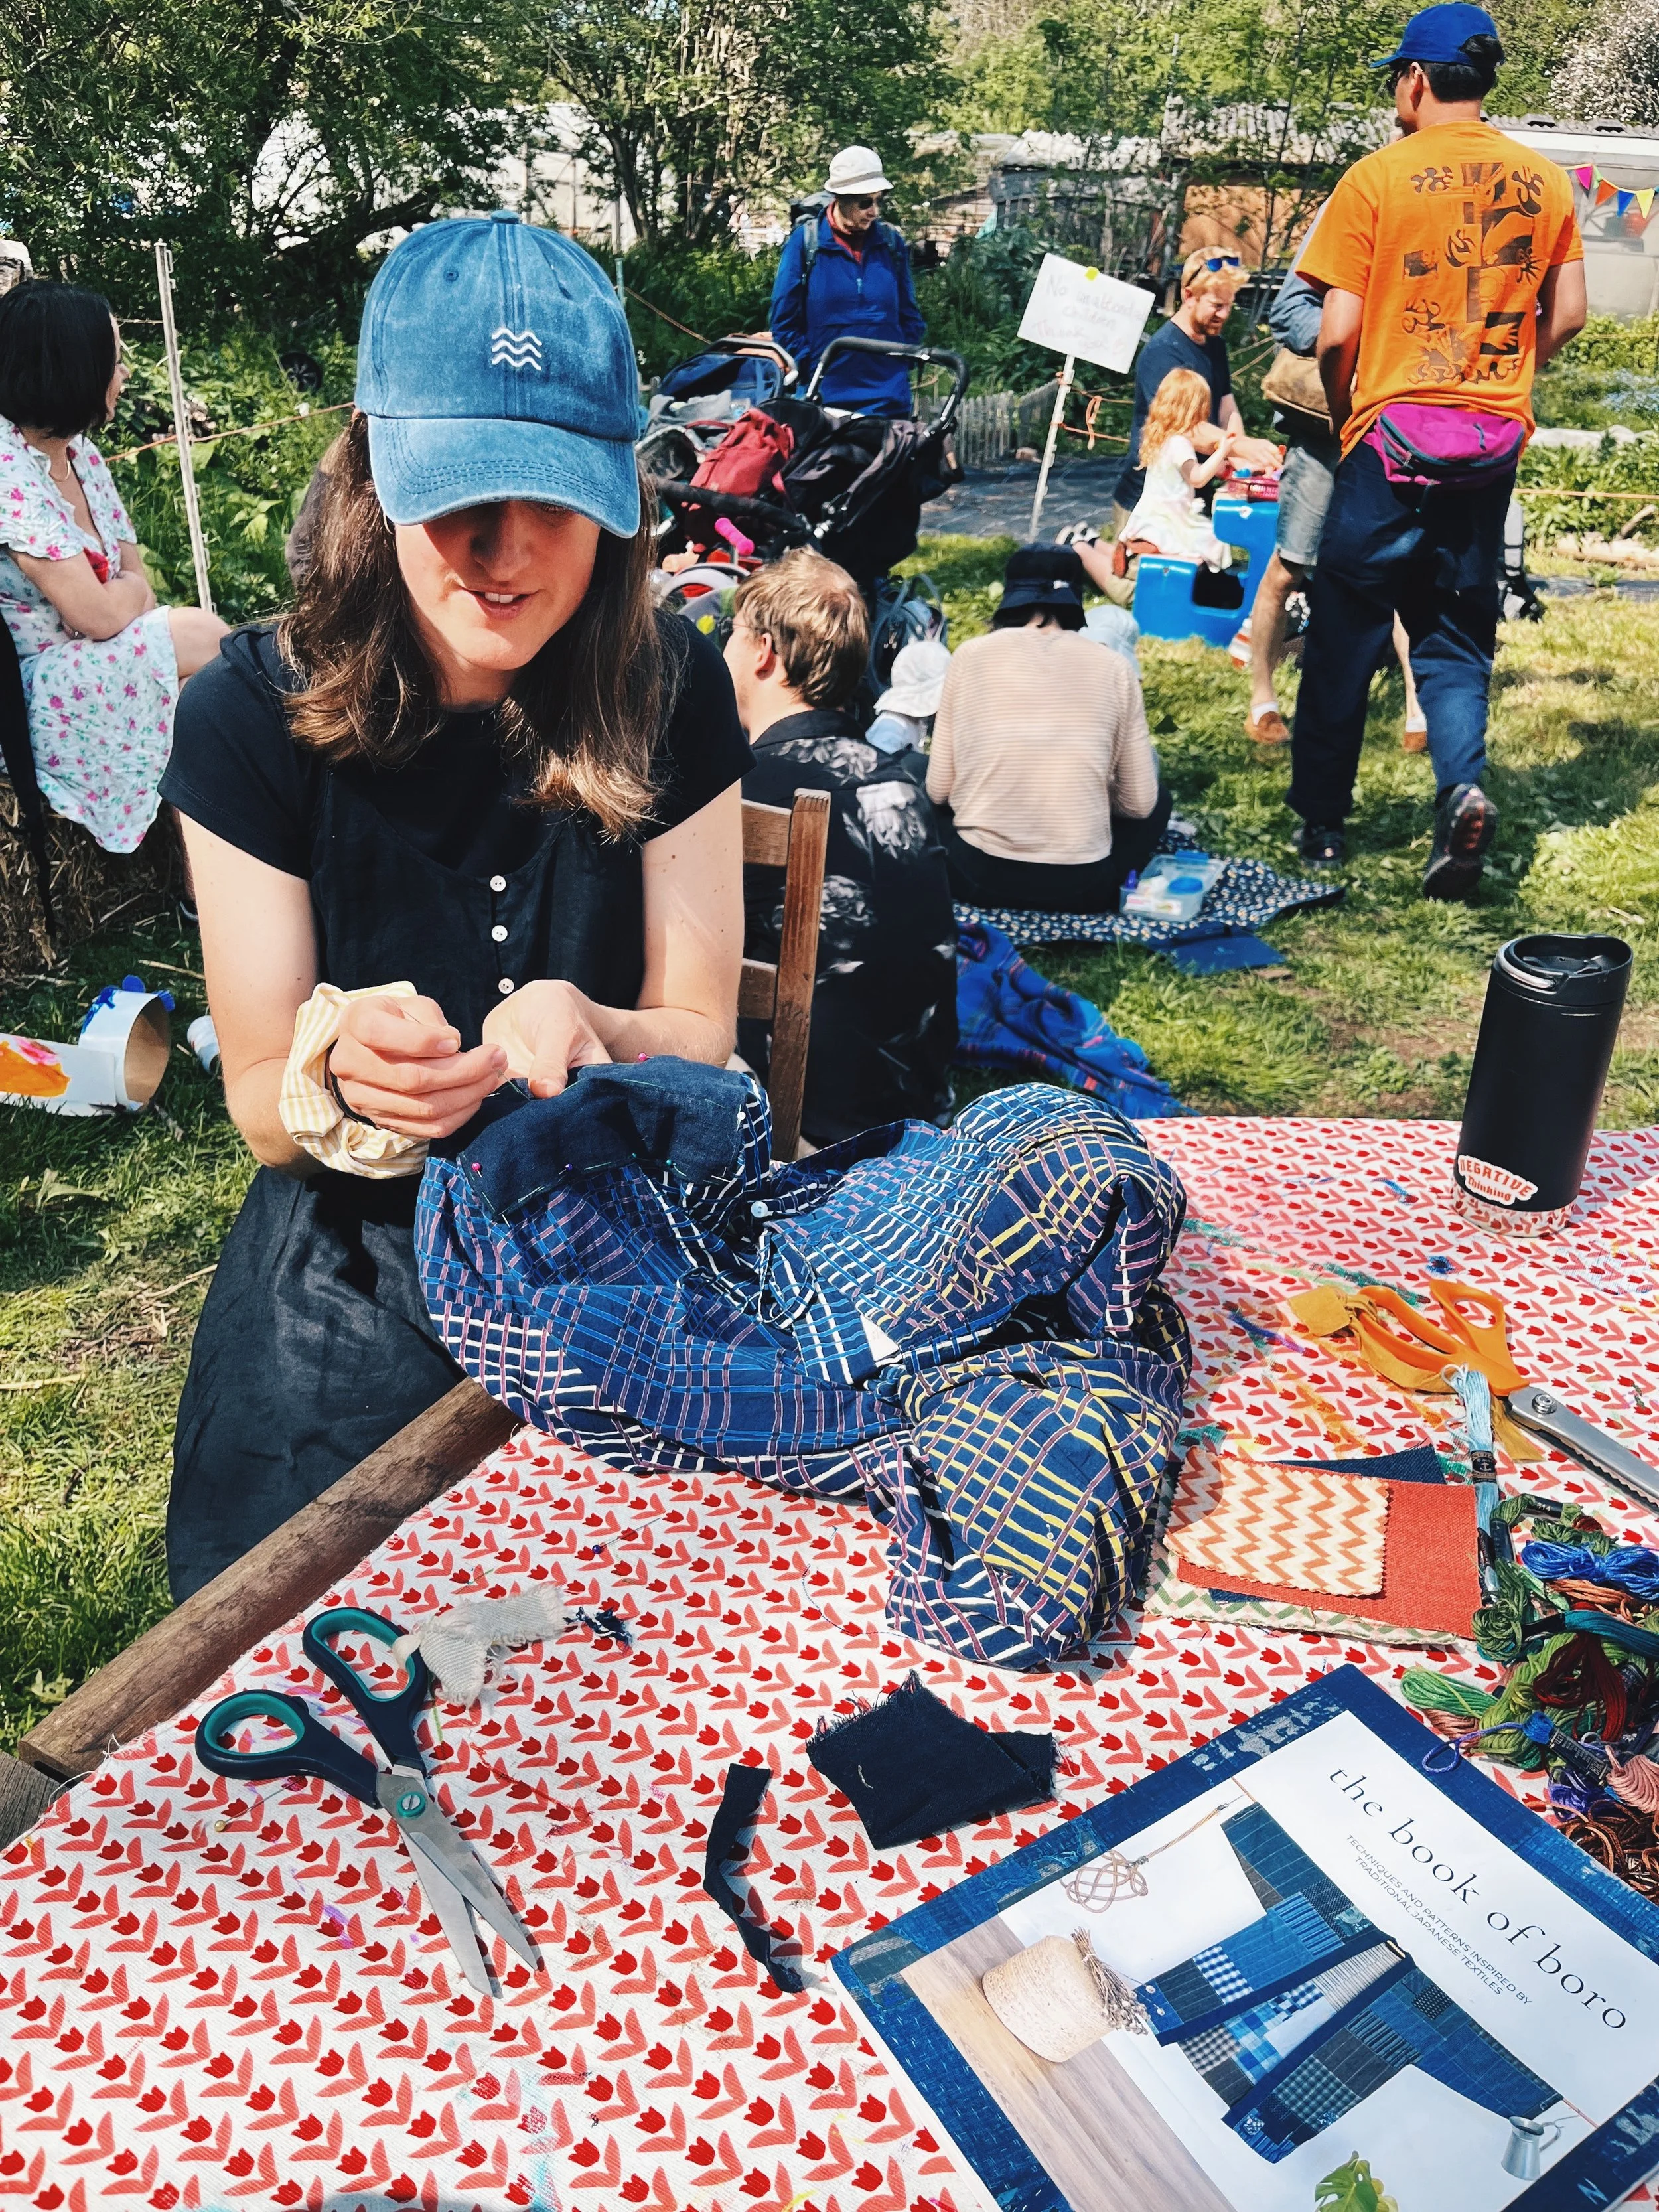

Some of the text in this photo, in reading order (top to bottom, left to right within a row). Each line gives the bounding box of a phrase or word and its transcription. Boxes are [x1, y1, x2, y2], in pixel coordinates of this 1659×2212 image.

[1046, 273, 1069, 297] No
[1329, 1768, 1626, 2028] the book of boro
[1346, 1834, 1532, 2004] TECHNIQUES AND PATTERNS INSPIRED BY
[1355, 1856, 1504, 1994] TRADITIONAL JAPANESE TEXTILES
